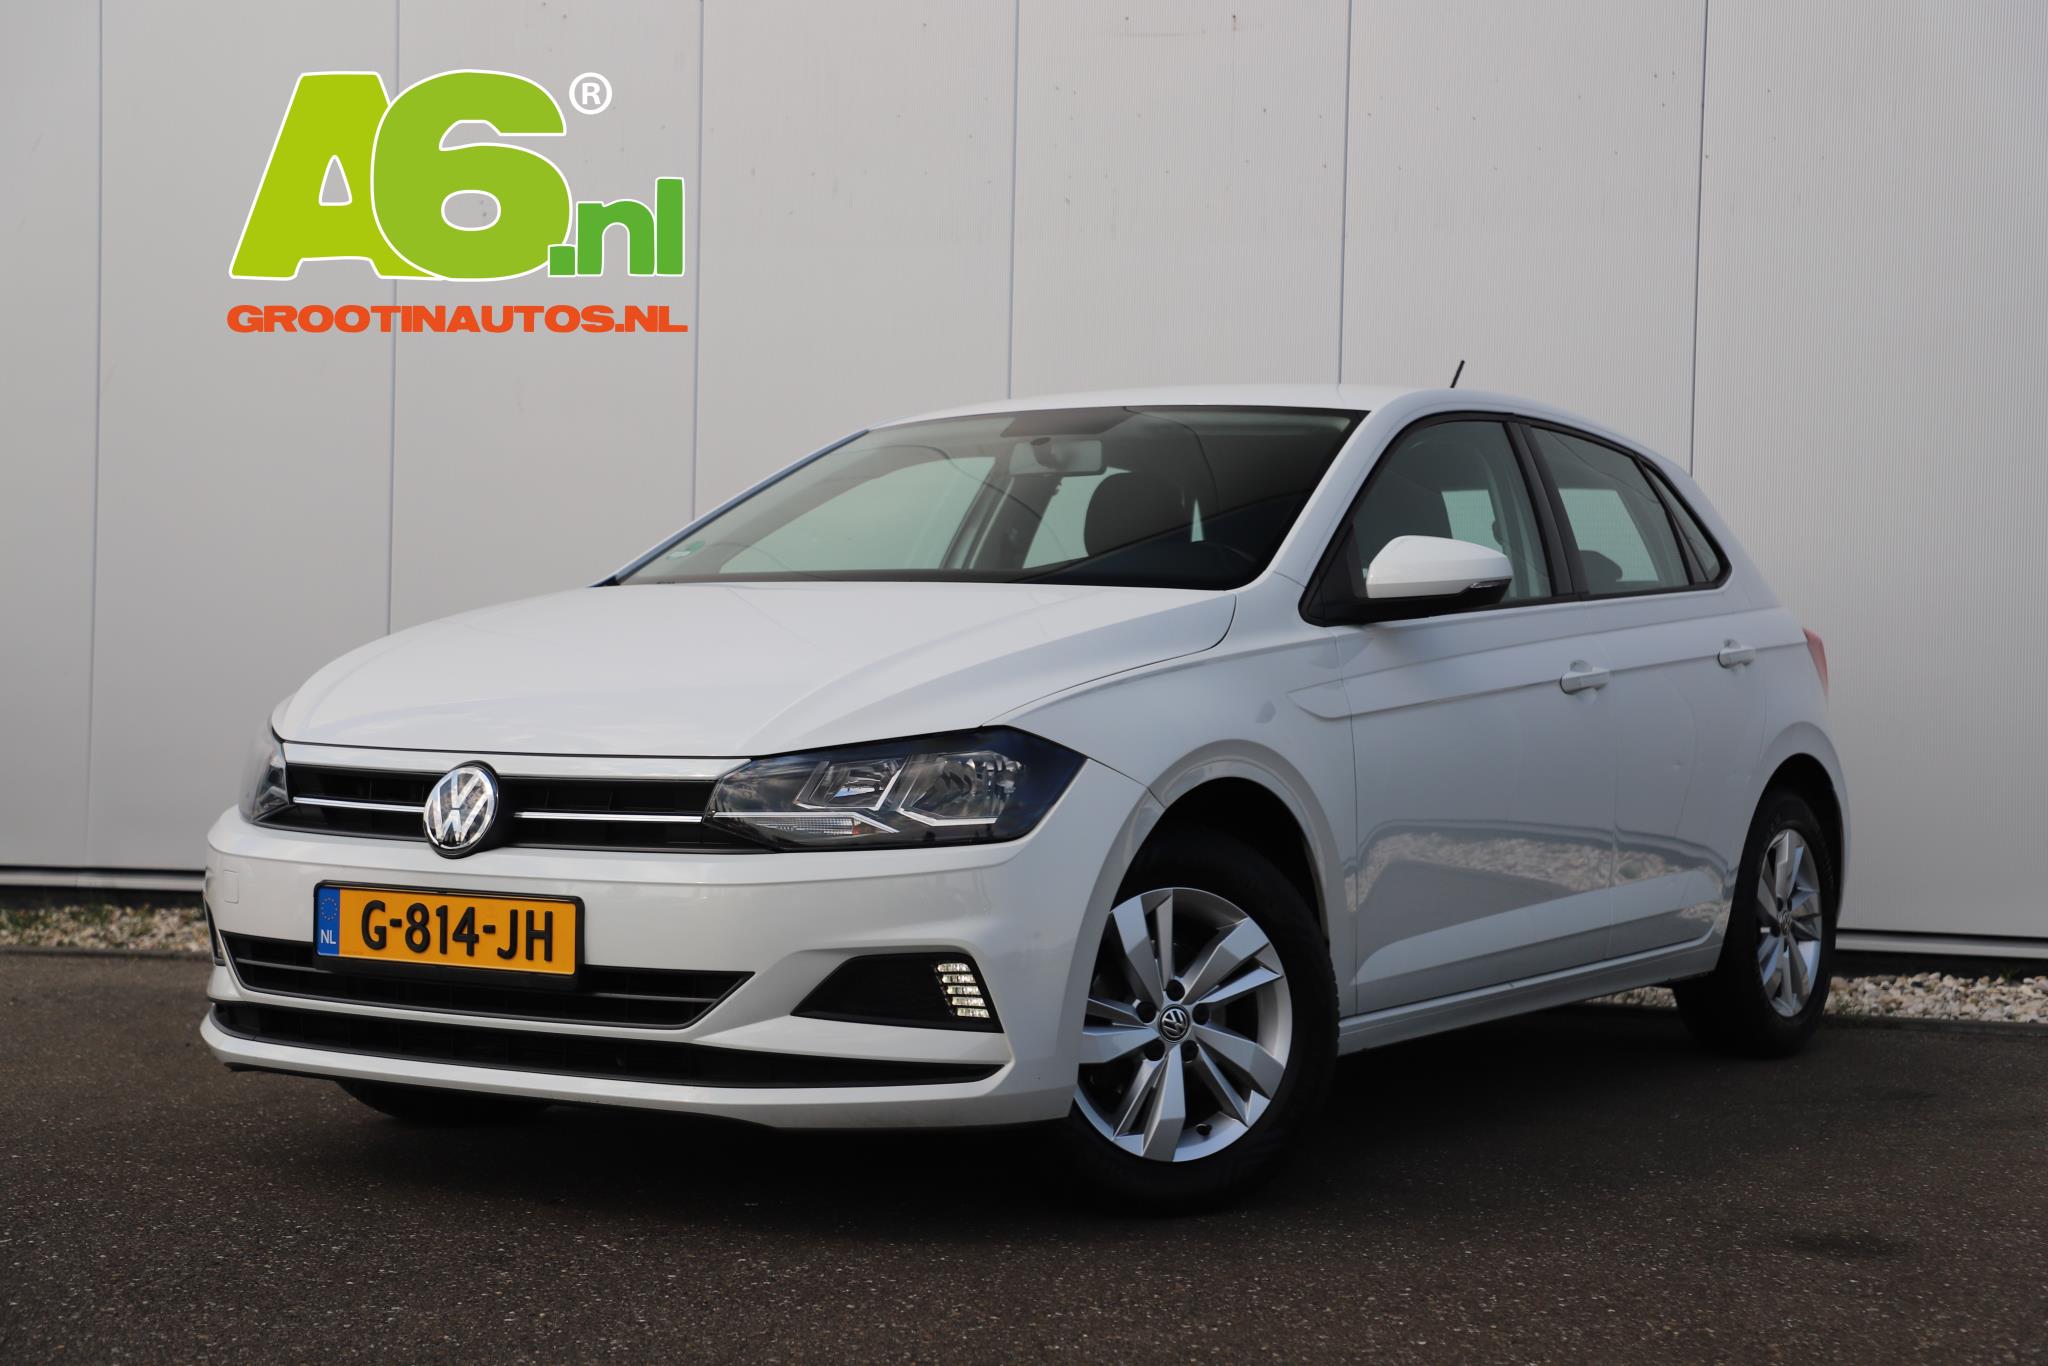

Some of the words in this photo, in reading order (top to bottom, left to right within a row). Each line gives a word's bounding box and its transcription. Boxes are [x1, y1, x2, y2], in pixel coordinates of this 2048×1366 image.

[425, 766, 497, 848] VW
[320, 929, 337, 945] NL
[361, 900, 553, 962] G-814-JH
